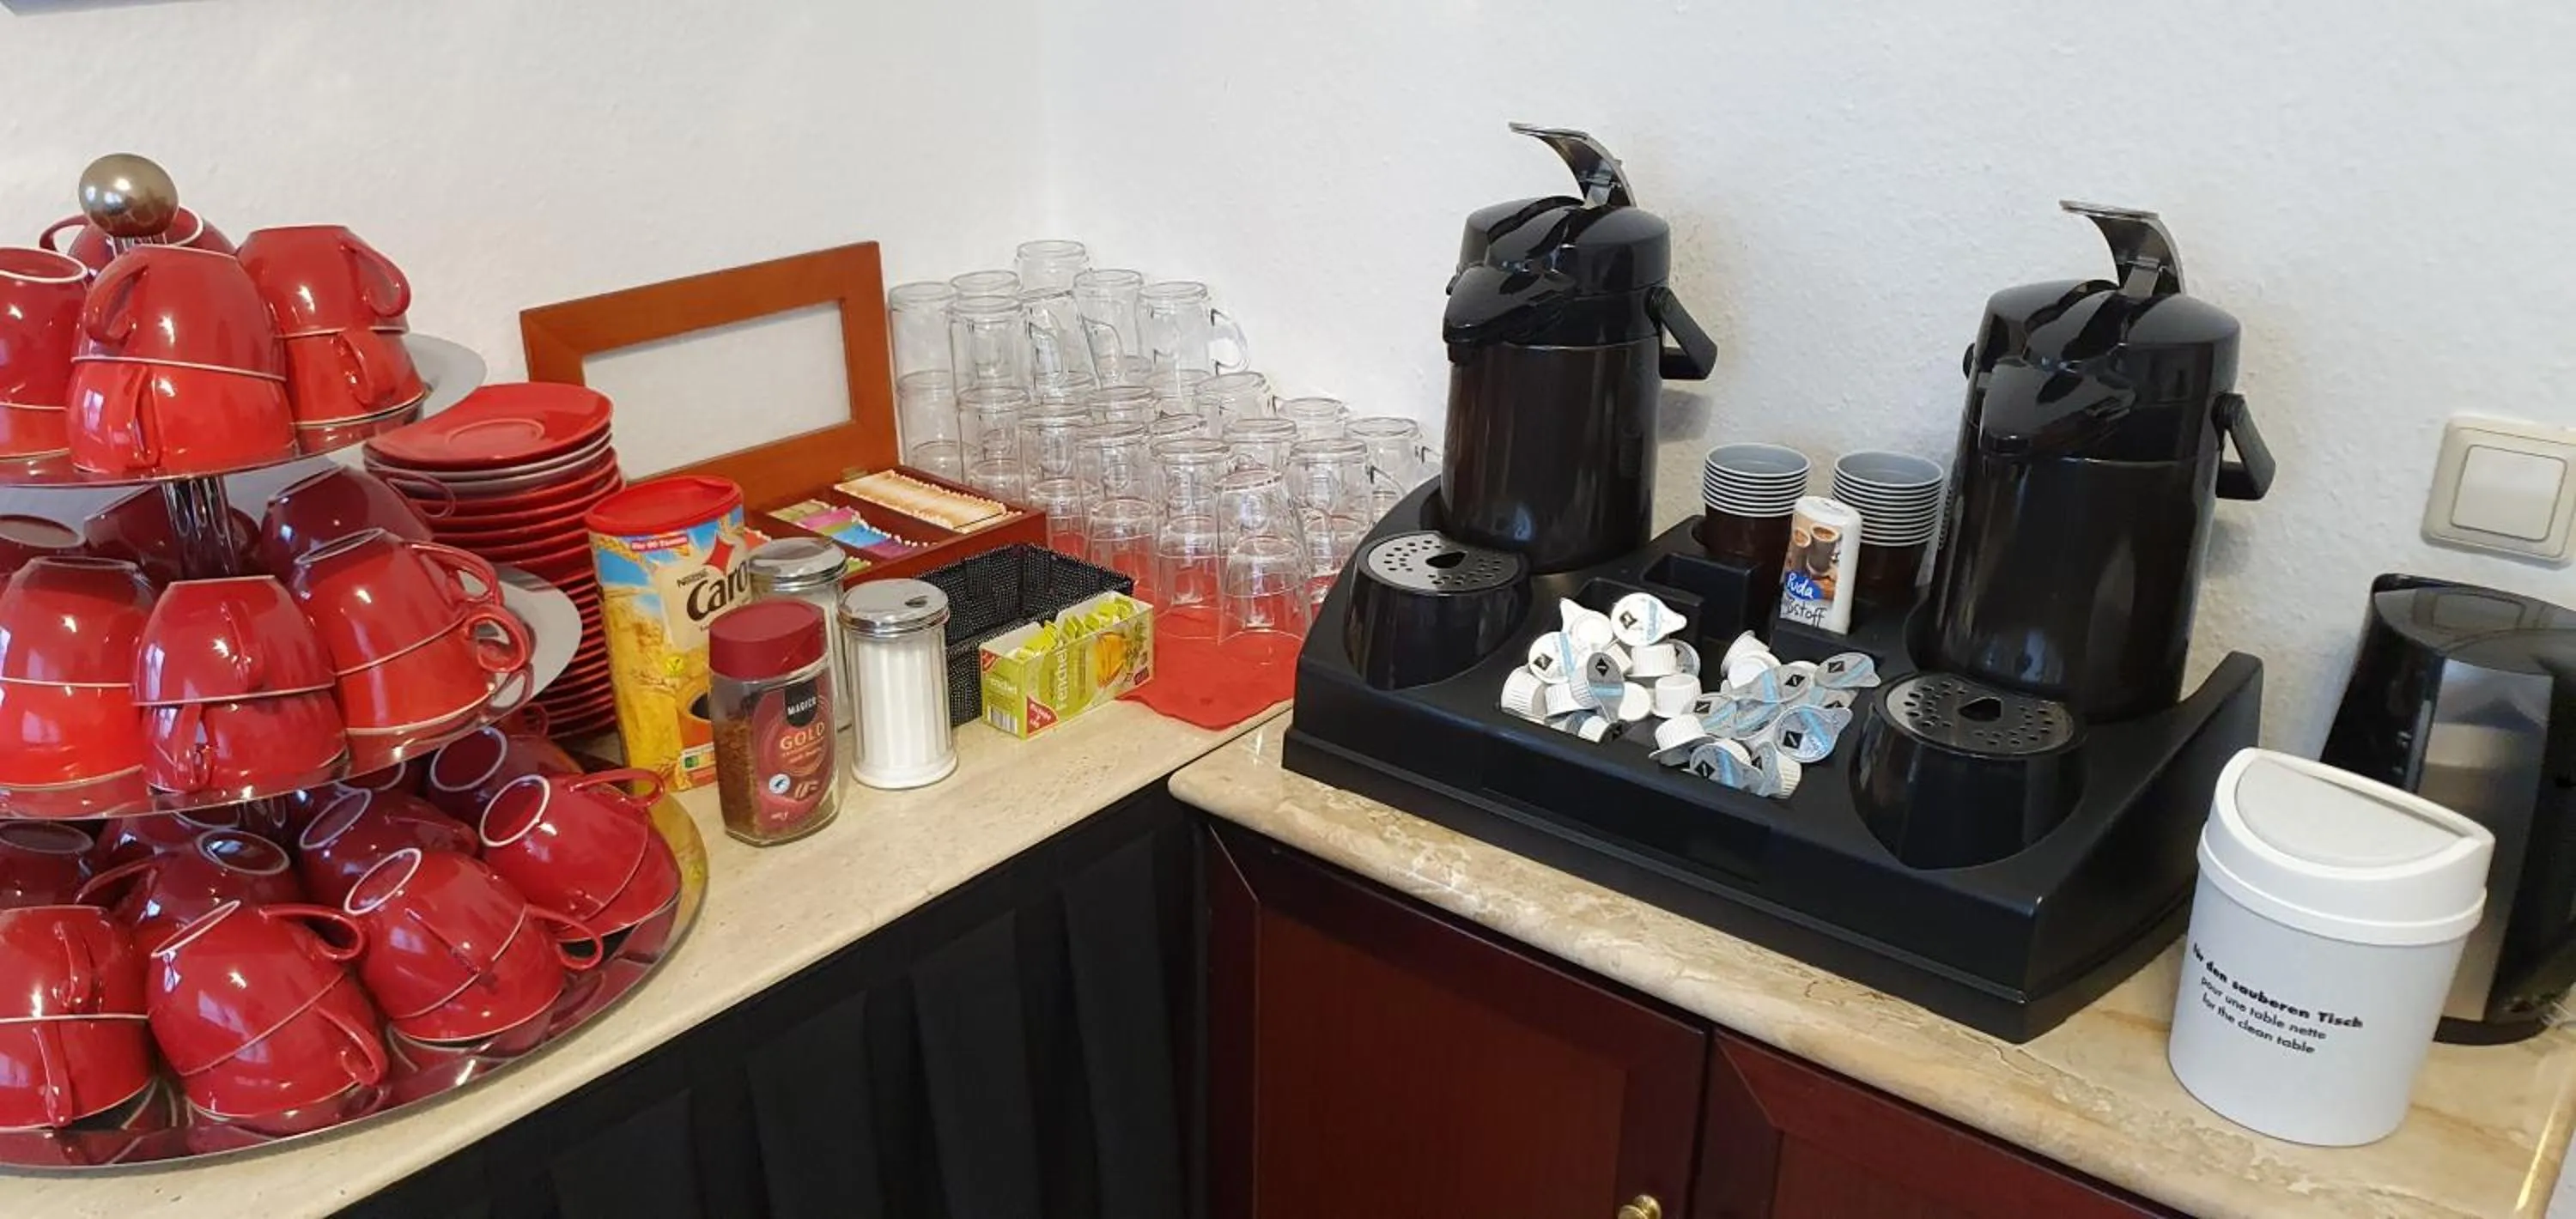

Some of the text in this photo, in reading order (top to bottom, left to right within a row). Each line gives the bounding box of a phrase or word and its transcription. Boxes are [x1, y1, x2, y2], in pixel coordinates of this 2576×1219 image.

[687, 559, 749, 622] Caro
[779, 721, 825, 750] GOLD
[2201, 976, 2326, 1040] pour une table nette
[2206, 961, 2228, 984] den
[2232, 980, 2310, 1019] sauberen
[2318, 1011, 2363, 1028] Tisch
[2217, 1005, 2236, 1023] the
[2238, 1020, 2273, 1041] clean
[2275, 1035, 2315, 1054] table
